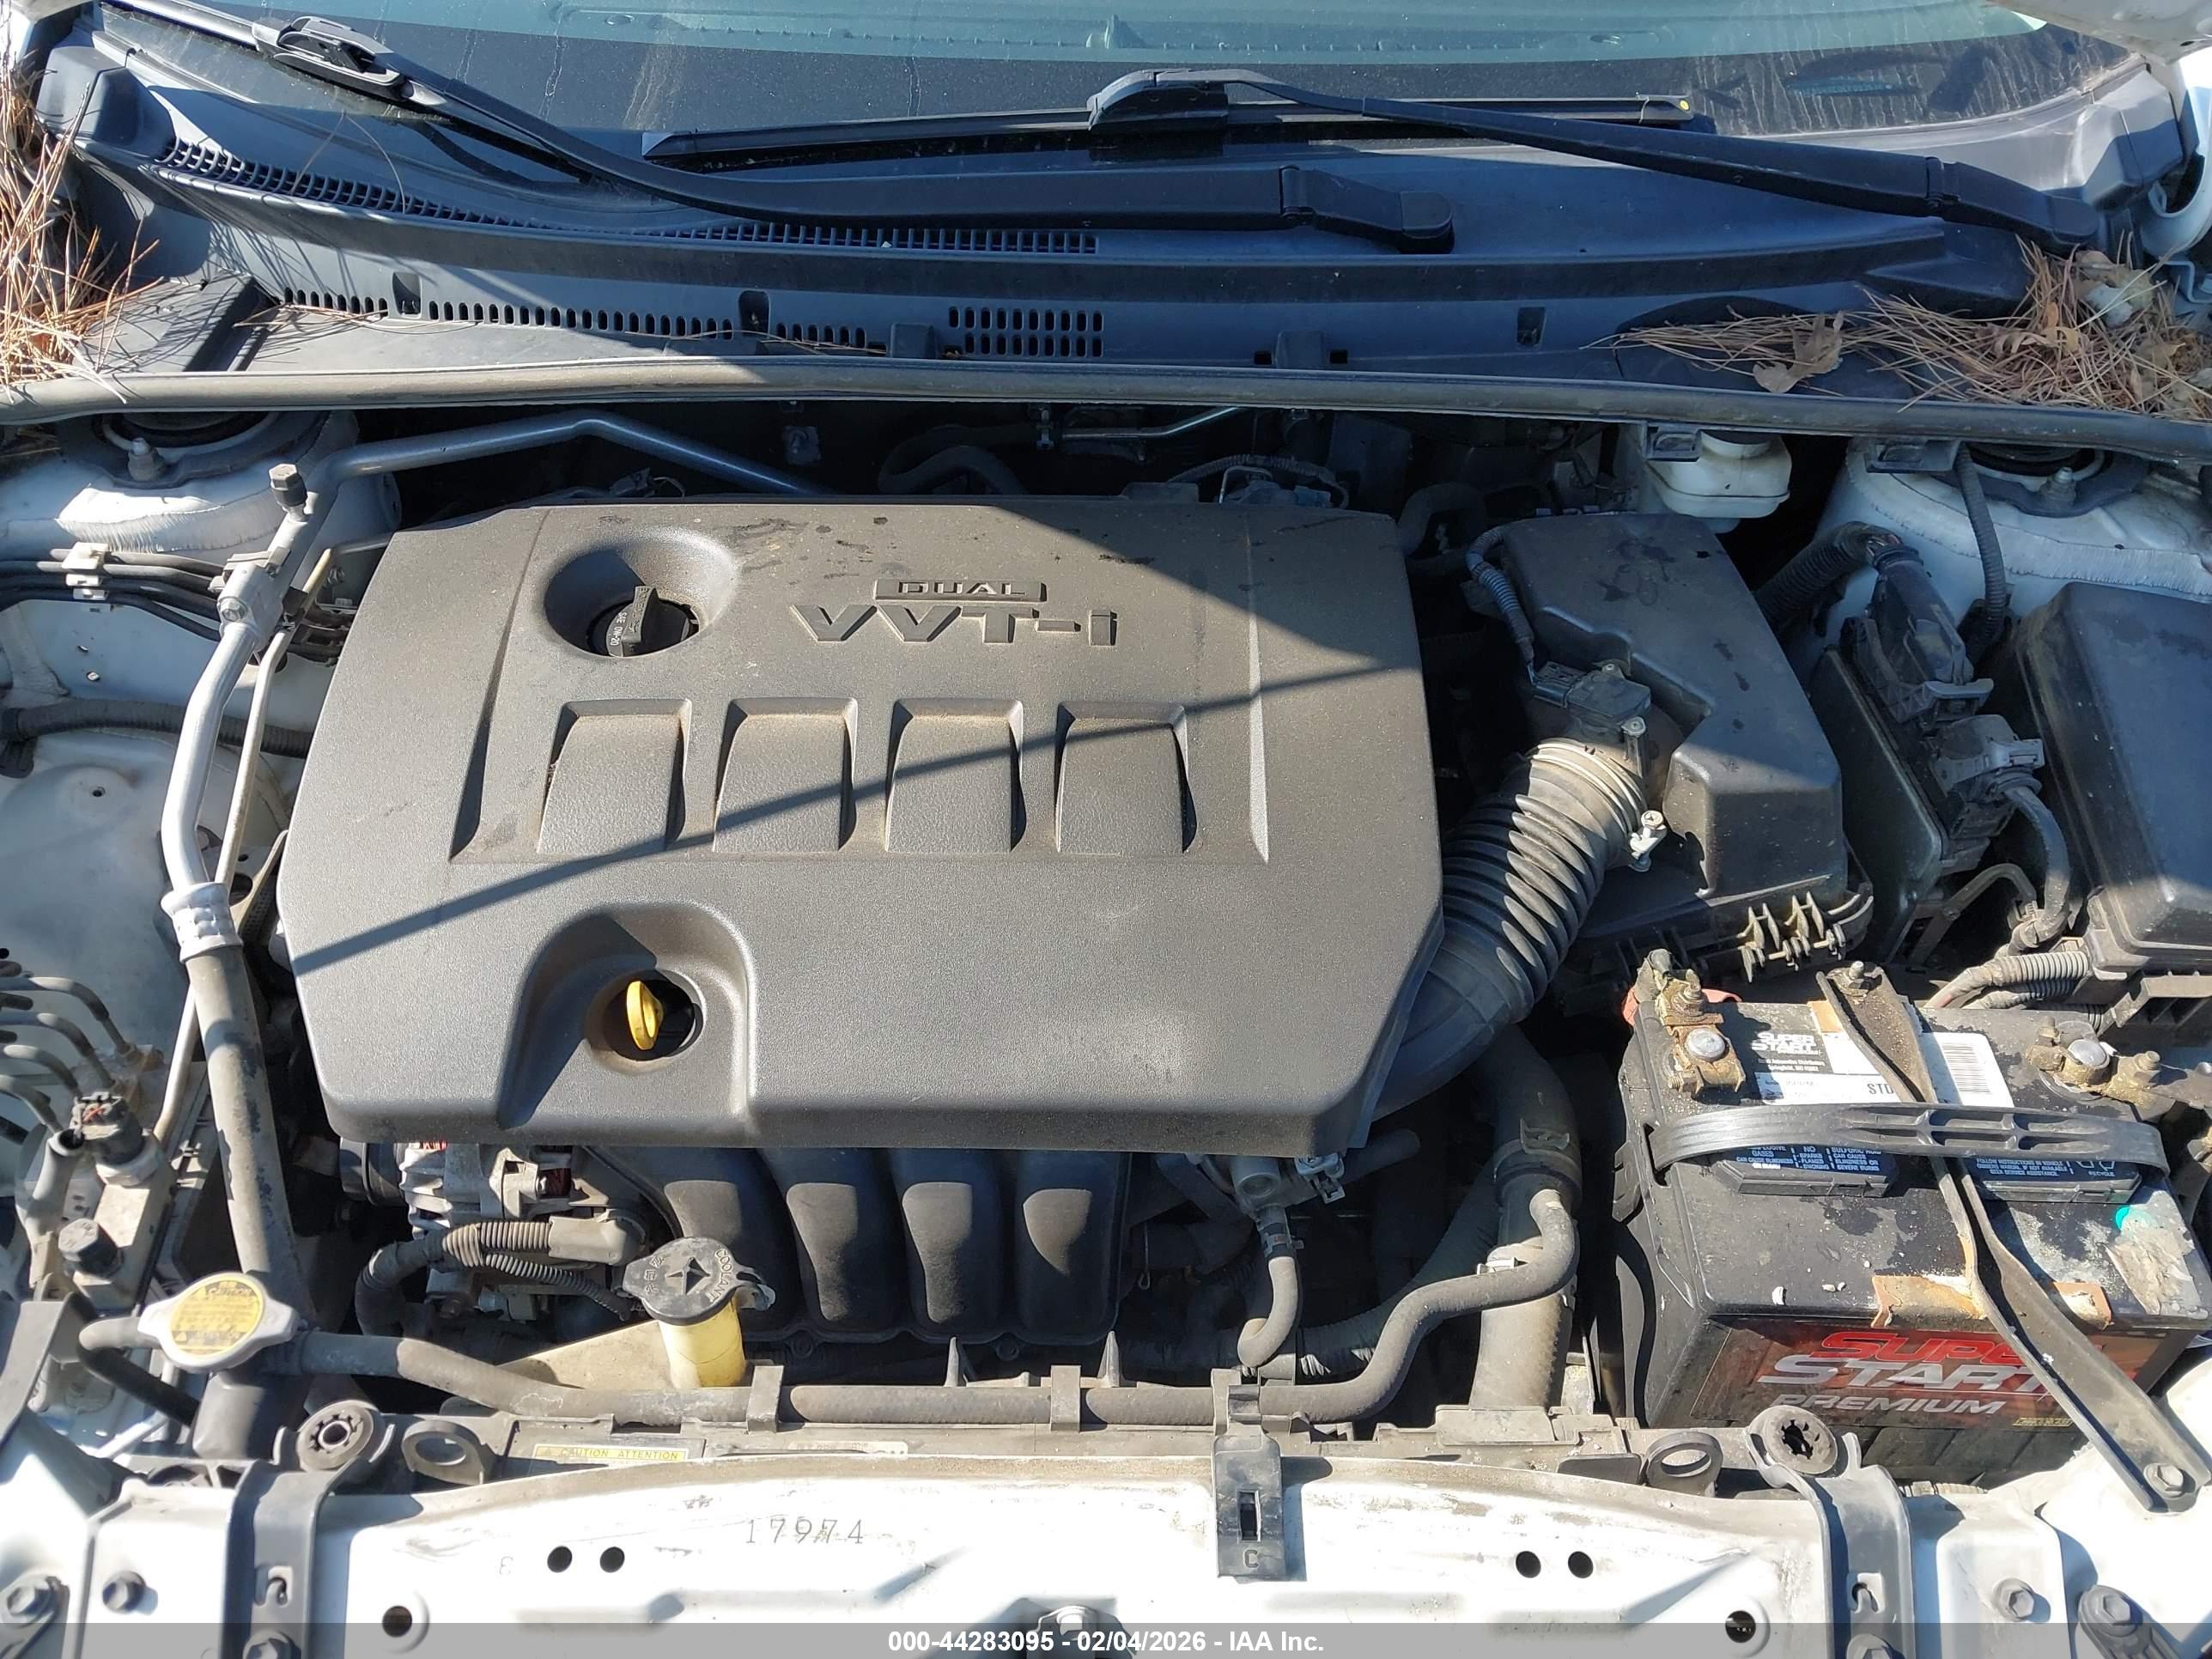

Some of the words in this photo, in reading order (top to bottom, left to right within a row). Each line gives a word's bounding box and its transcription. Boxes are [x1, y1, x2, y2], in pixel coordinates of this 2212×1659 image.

[897, 581, 1028, 597] DUAL
[617, 611, 628, 624] SAE
[790, 605, 1118, 647] VVT-i
[1751, 1039, 1817, 1051] START
[1757, 1031, 1815, 1043] SUPER
[705, 1248, 733, 1303] COOLANT
[1809, 1331, 2027, 1365] SUPE
[1770, 1393, 2007, 1414] PREMIUM
[560, 1449, 609, 1458] CAUTION
[617, 1449, 679, 1460] ATTENTION
[745, 1517, 865, 1545] 17974
